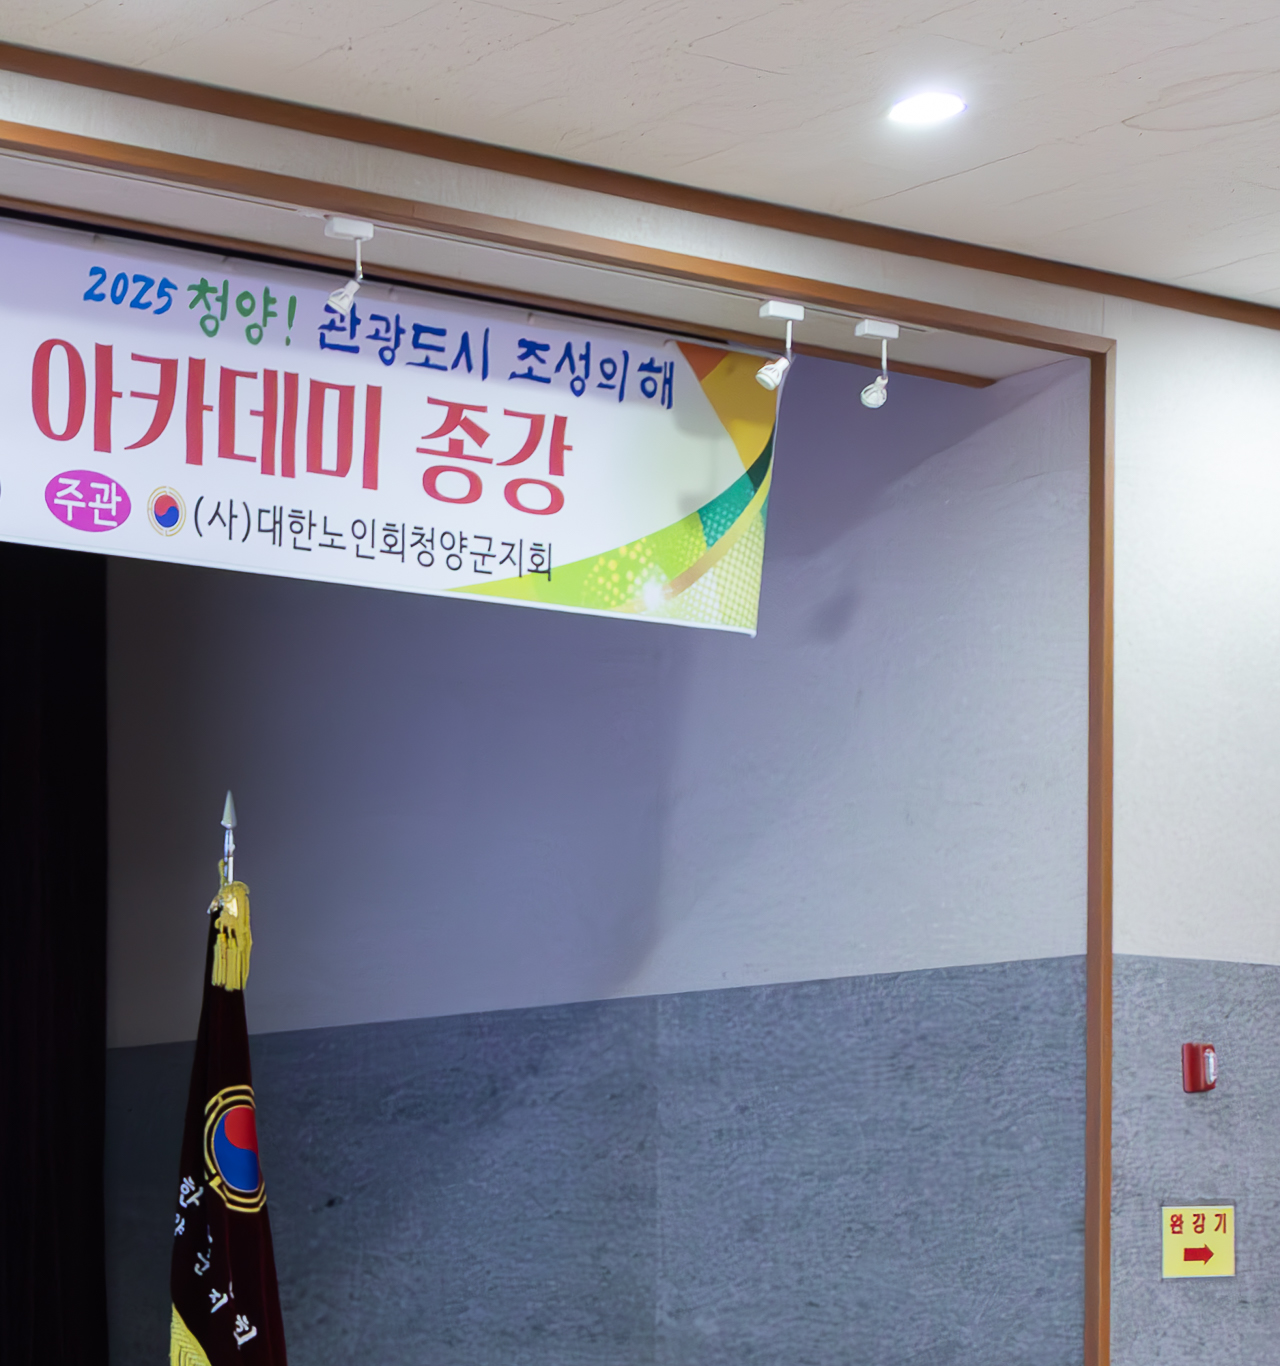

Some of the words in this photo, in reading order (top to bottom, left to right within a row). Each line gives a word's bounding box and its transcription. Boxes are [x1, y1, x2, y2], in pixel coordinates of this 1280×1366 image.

[83, 266, 178, 315] 2025
[187, 277, 297, 346] 청양!
[317, 302, 490, 381] 관광도시
[31, 338, 383, 490] 아카데미
[416, 396, 573, 516] 종강
[53, 479, 122, 528] 주관
[193, 496, 553, 581] (사)대한노인회청양군지회
[1170, 1213, 1227, 1235] 완강기
